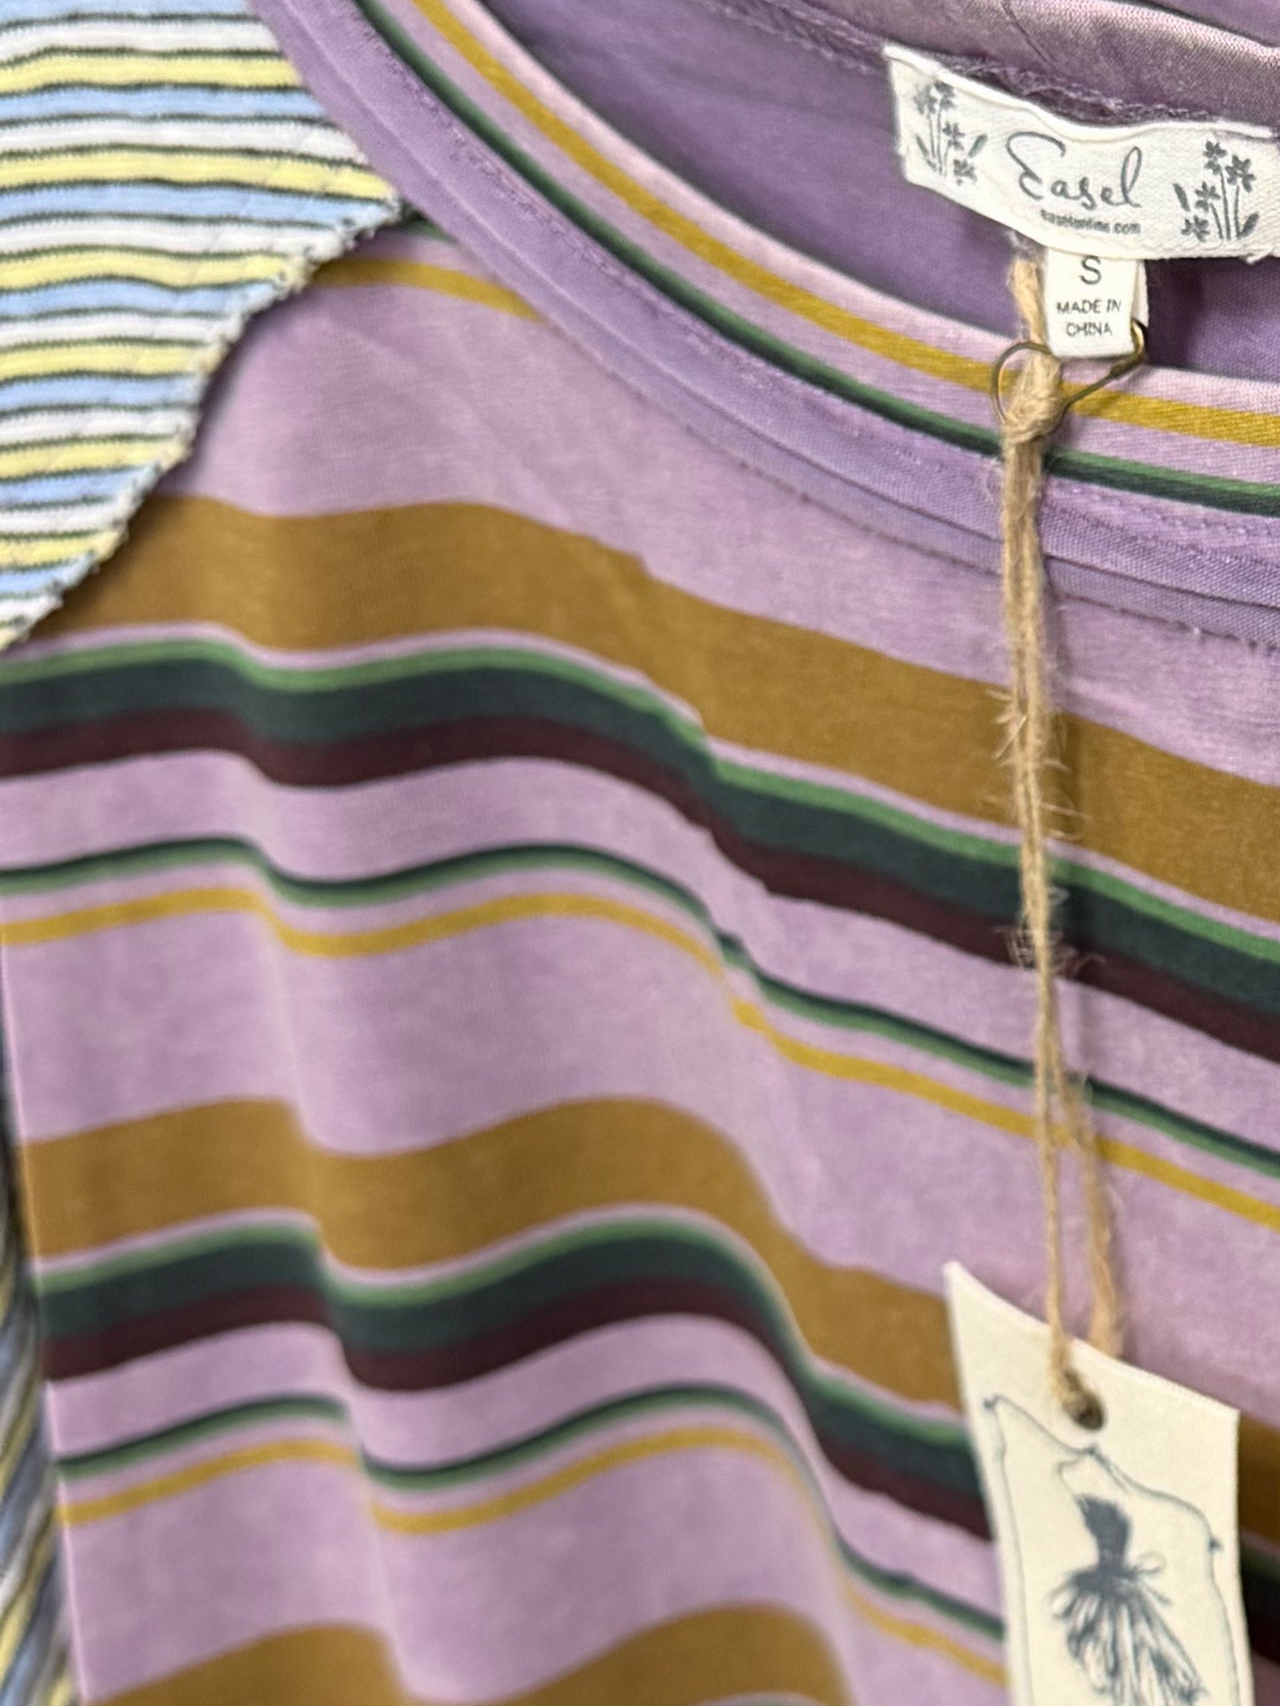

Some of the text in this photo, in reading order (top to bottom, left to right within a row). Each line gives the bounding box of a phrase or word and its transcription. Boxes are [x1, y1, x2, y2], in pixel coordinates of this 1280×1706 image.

[1005, 131, 1142, 211] Easel
[1080, 254, 1102, 285] S
[1056, 298, 1122, 314] MADE IN
[1065, 321, 1113, 337] CHINA
